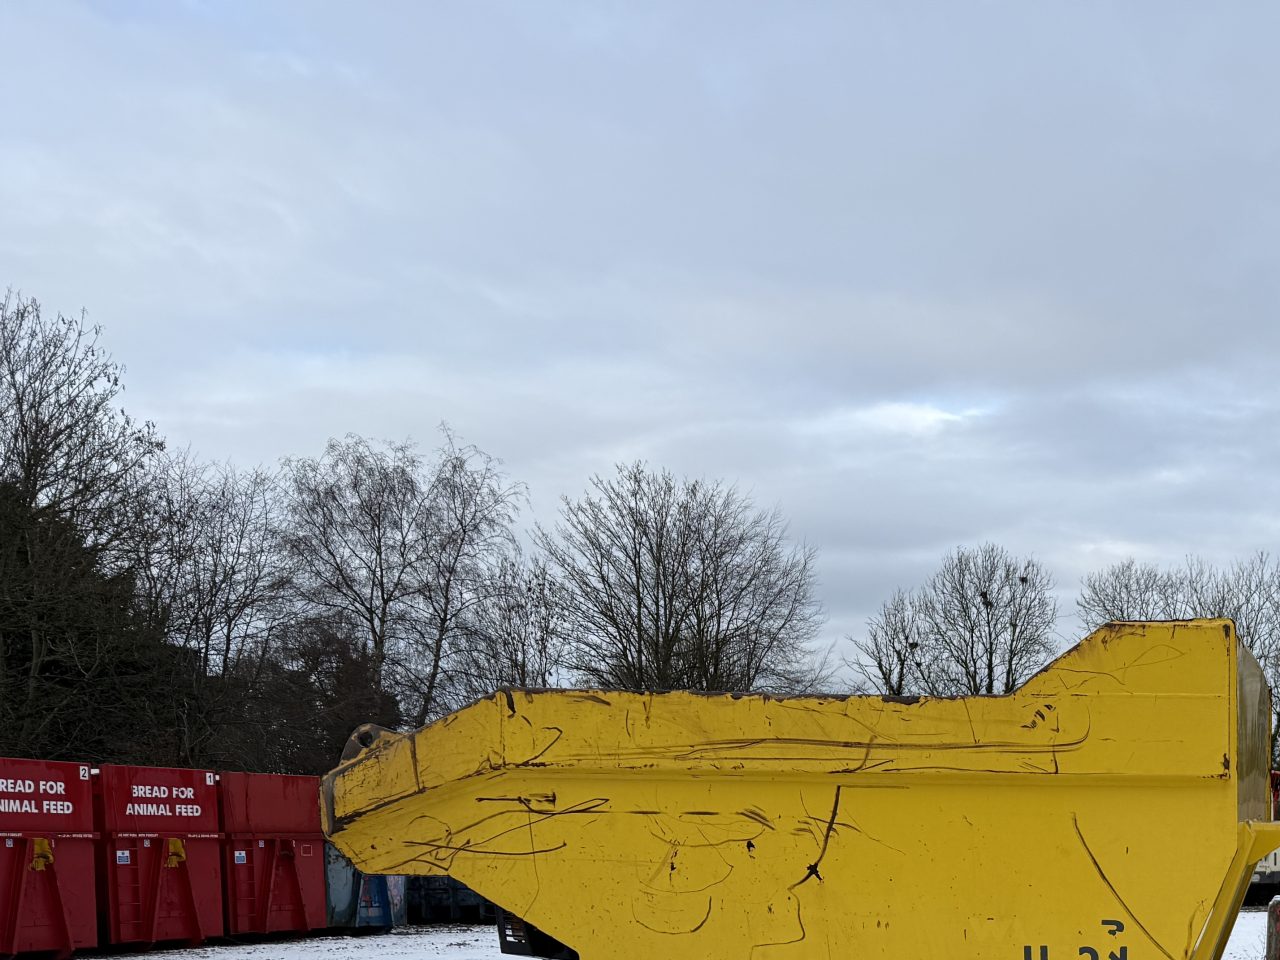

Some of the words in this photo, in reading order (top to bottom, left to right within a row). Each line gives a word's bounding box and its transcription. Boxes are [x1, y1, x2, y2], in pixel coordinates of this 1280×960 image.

[39, 781, 66, 795] FOR
[131, 785, 168, 798] BREAD
[172, 787, 195, 799] FOR
[43, 801, 73, 814] FEED
[126, 803, 172, 816] ANIMAL
[175, 805, 201, 817] FEED
